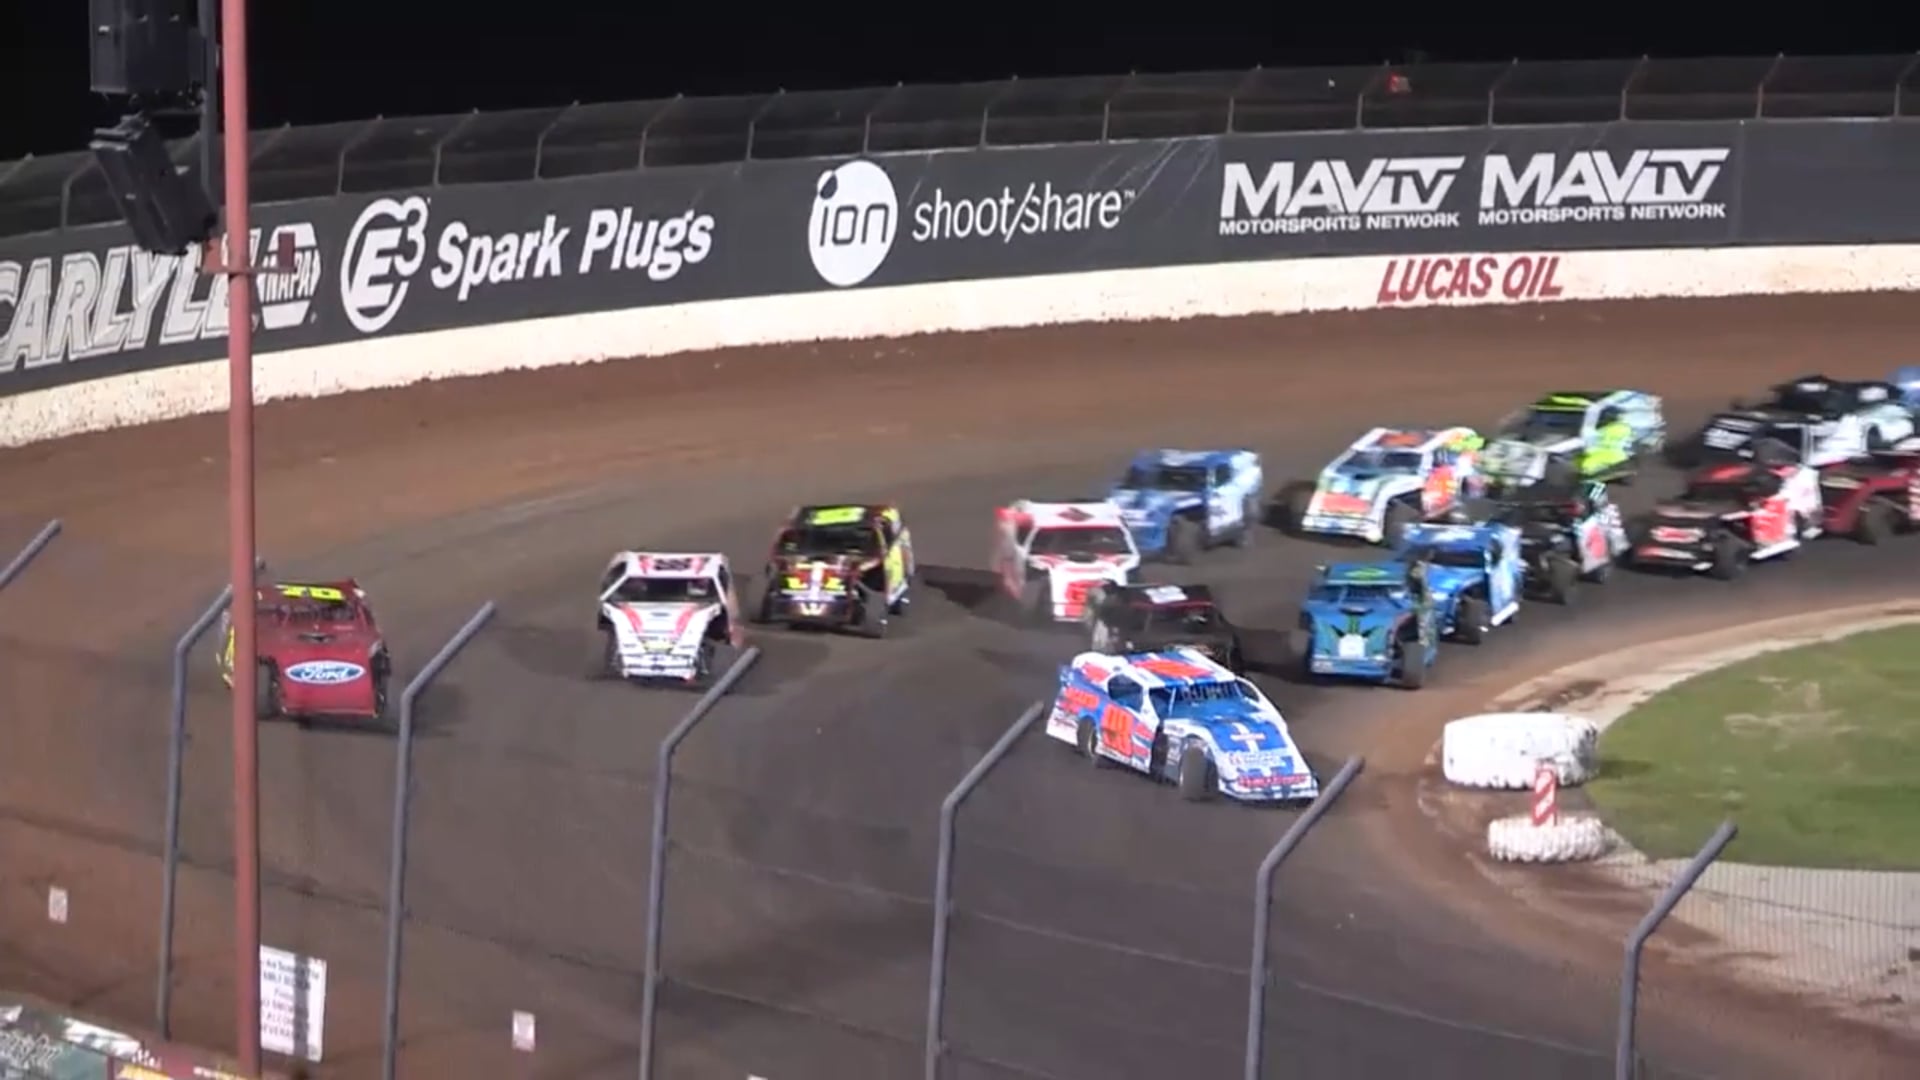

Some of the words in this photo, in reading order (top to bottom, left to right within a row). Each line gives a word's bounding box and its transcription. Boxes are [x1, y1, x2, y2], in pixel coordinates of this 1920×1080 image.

[1220, 156, 1466, 218] MAVTV
[1480, 148, 1731, 209] MAVTV
[815, 171, 892, 249] ion
[1219, 215, 1361, 236] MOTORSPORTS
[1365, 211, 1461, 230] NETWORK
[1478, 205, 1626, 226] MOTORSPORTS
[1630, 202, 1727, 220] NETWORK
[431, 213, 571, 302] Spark
[578, 206, 716, 281] Plugs
[1377, 256, 1499, 304] LUCAS
[1502, 255, 1564, 300] OIL
[299, 662, 350, 682] Ford
